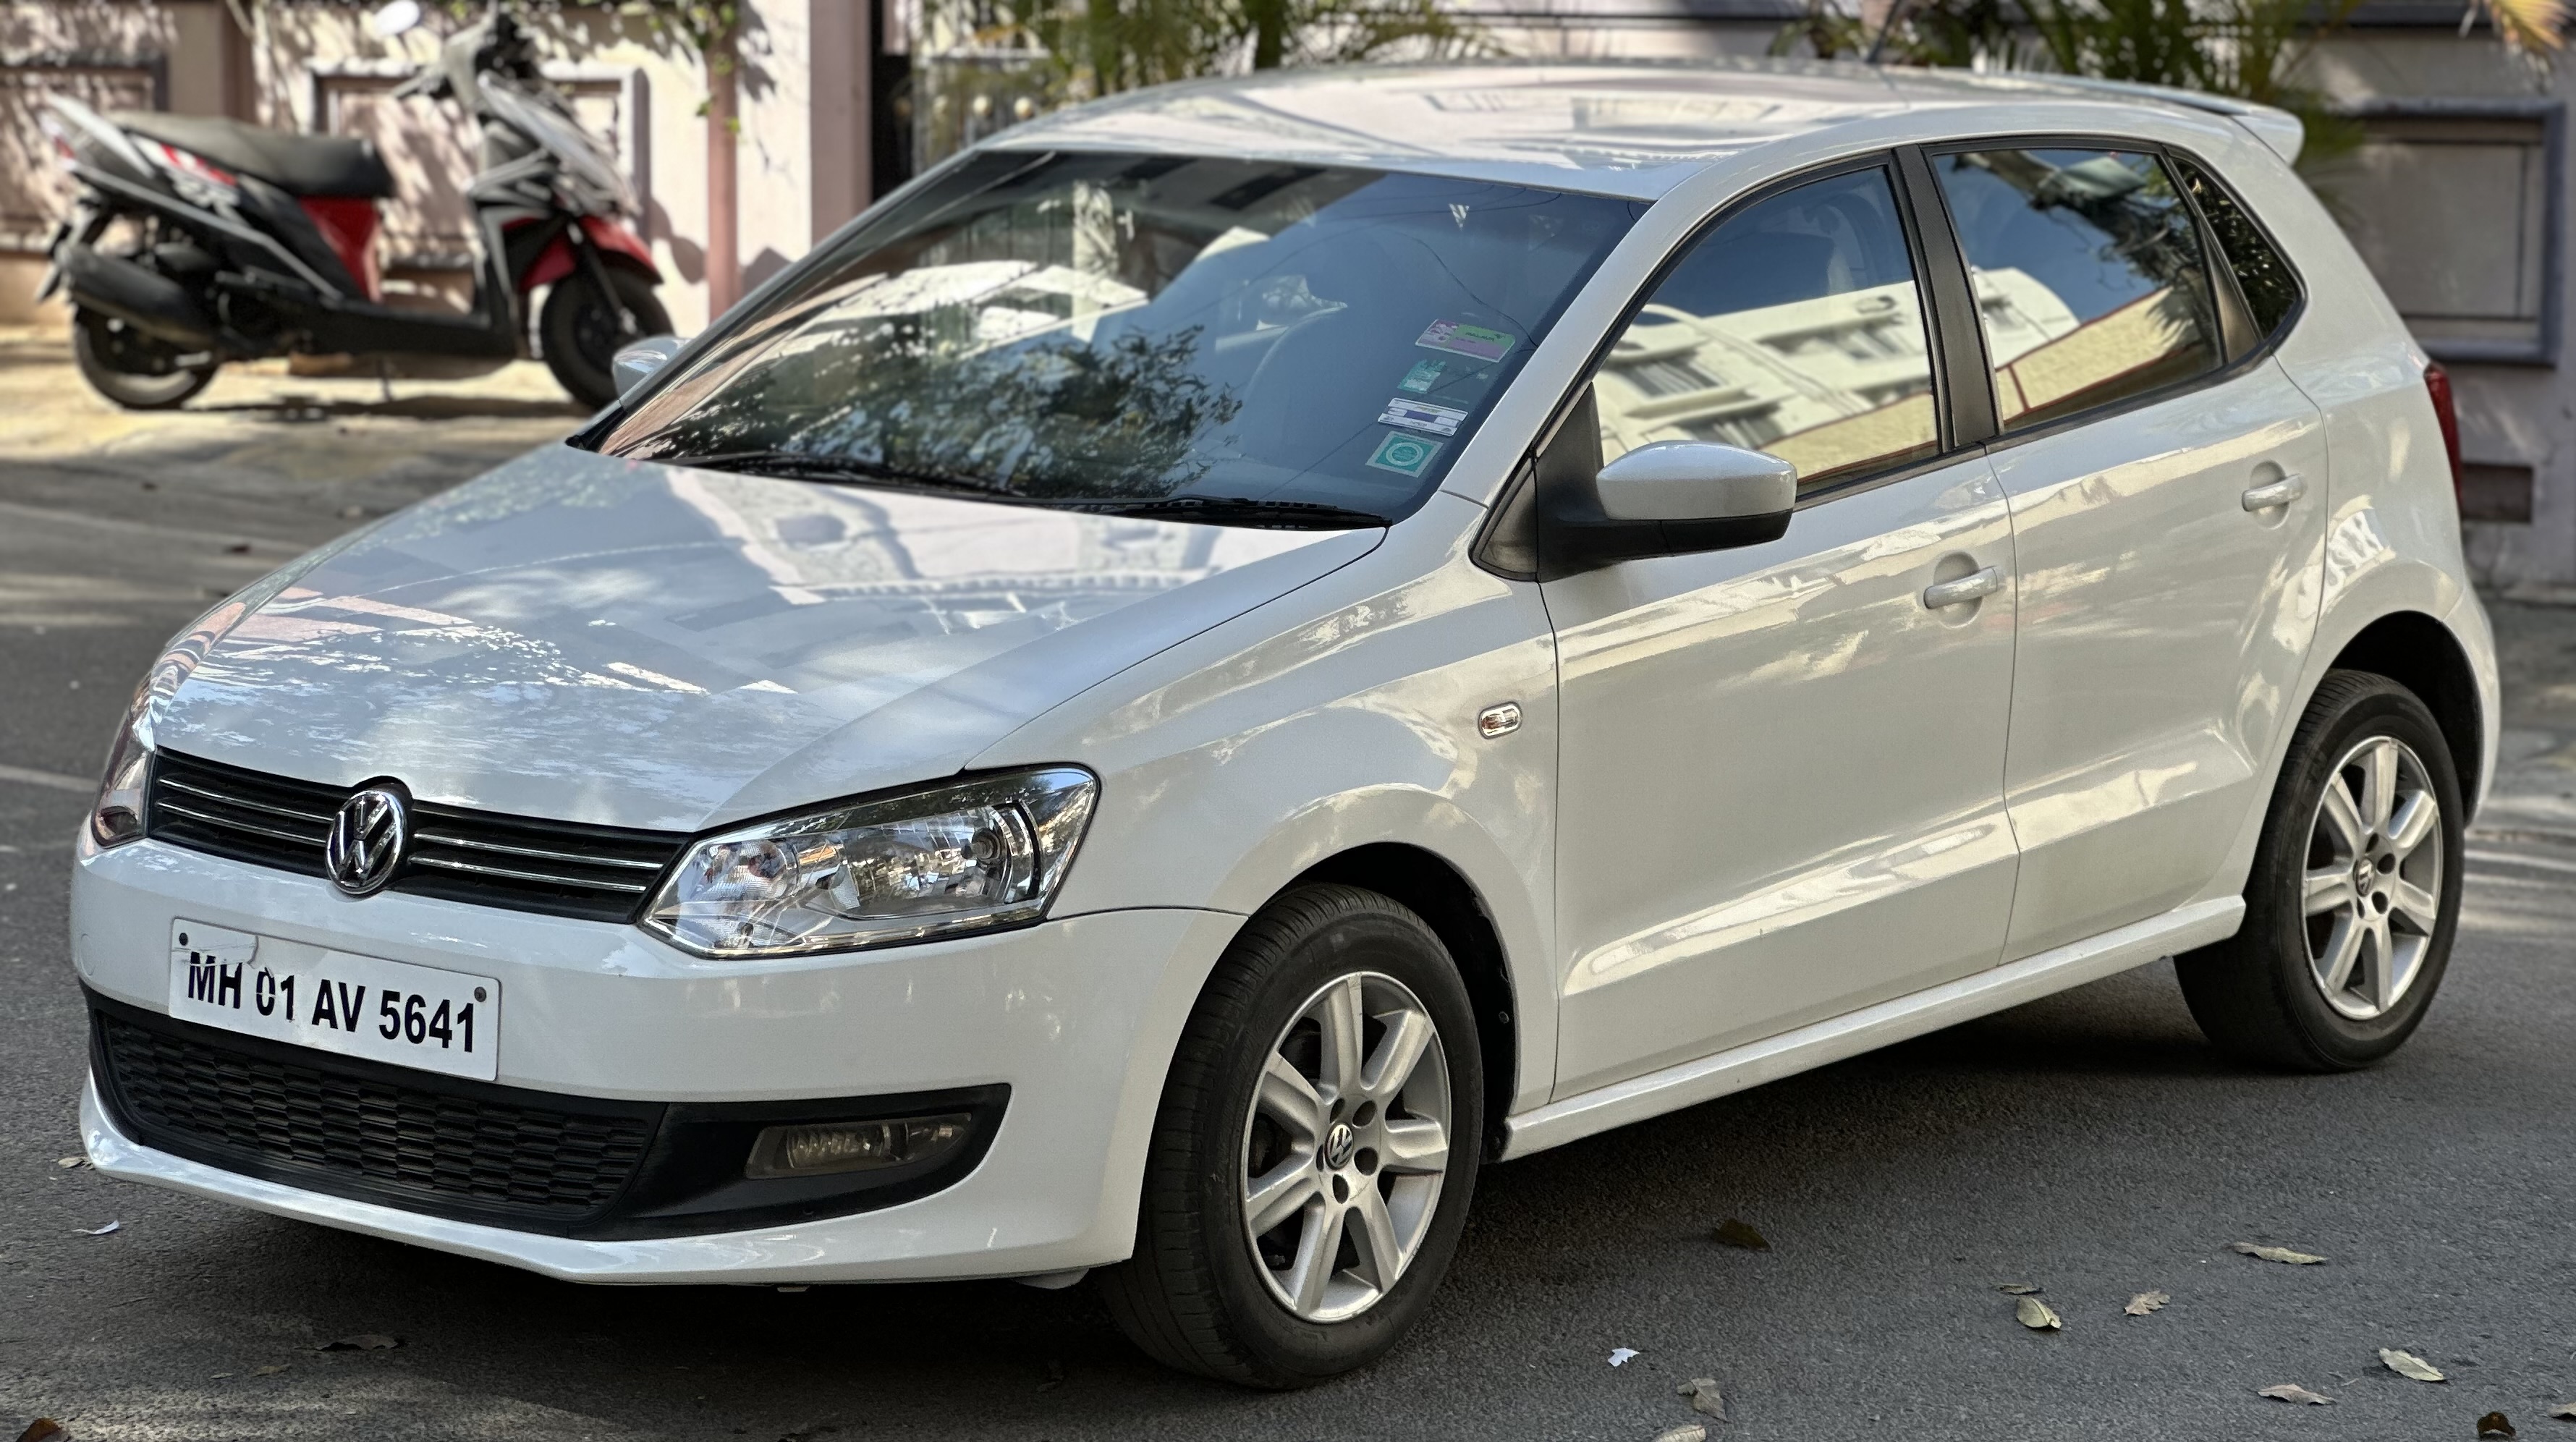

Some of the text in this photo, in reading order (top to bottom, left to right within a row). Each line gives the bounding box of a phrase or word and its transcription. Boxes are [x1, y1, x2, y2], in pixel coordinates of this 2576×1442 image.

[187, 951, 474, 1053] MH 01 AV 5641
